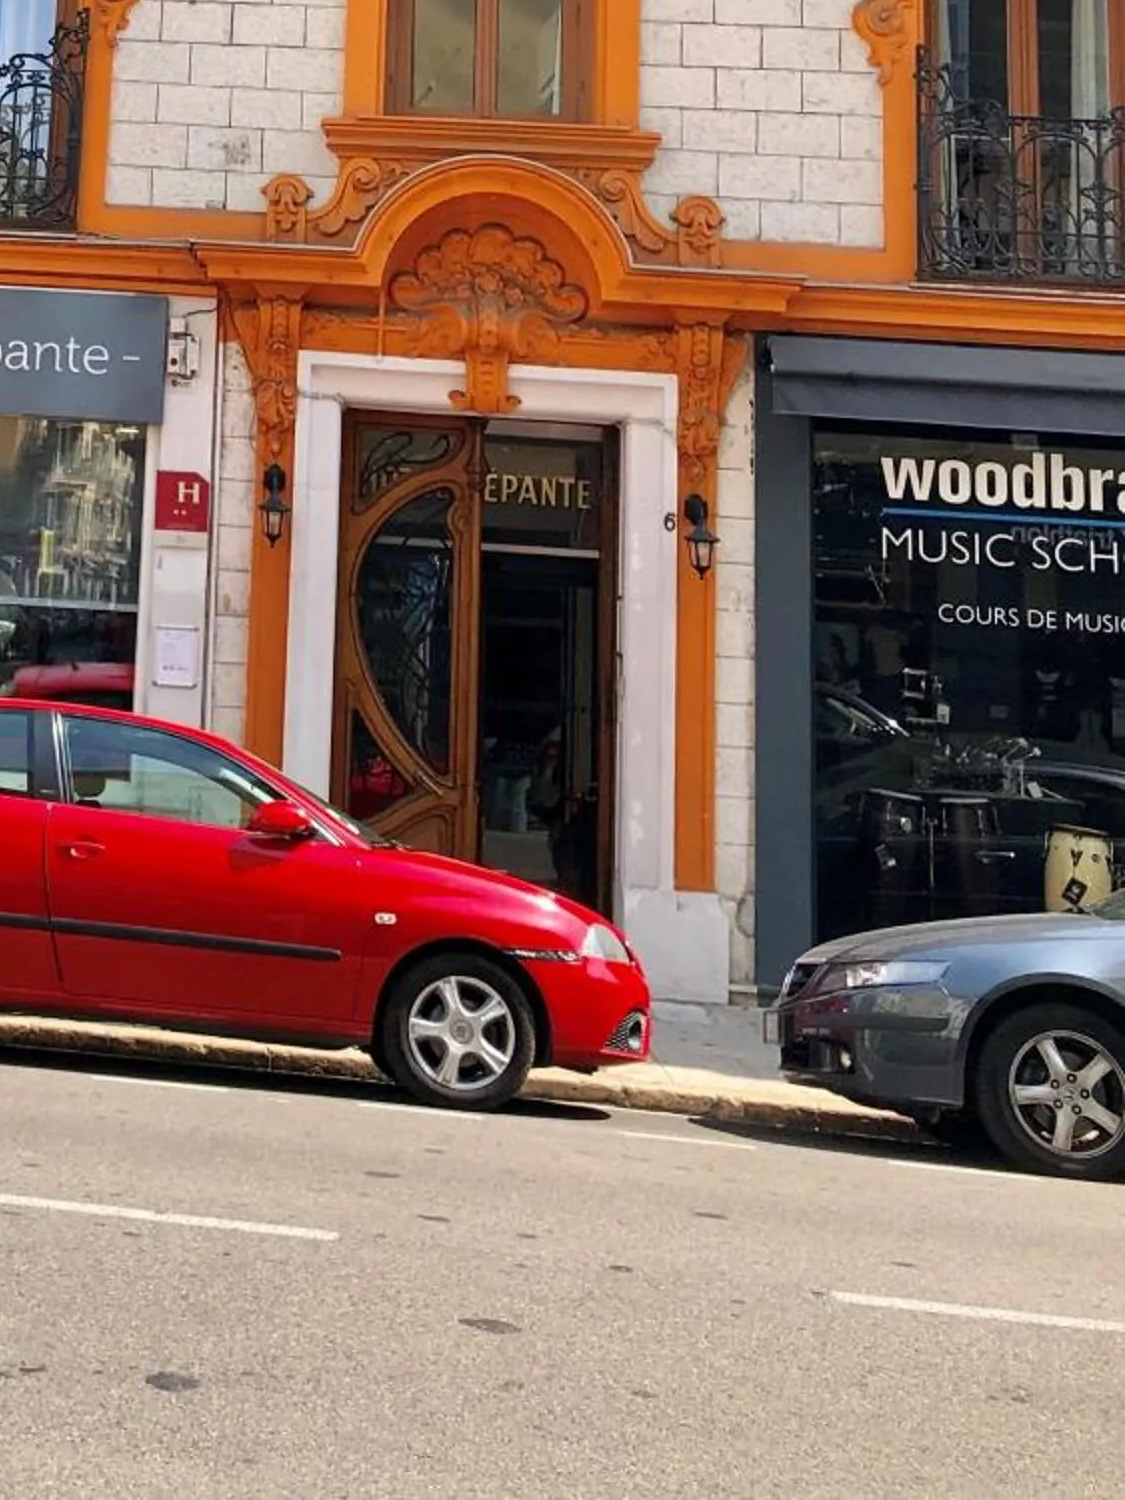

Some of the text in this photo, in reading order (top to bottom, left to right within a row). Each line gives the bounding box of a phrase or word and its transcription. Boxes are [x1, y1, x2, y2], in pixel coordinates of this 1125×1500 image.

[177, 481, 200, 505] H
[880, 452, 1125, 516] woodbr
[664, 512, 676, 532] 6
[881, 526, 1125, 575] MUSIC SCH
[938, 603, 1020, 627] COURS
[1027, 610, 1058, 630] DE
